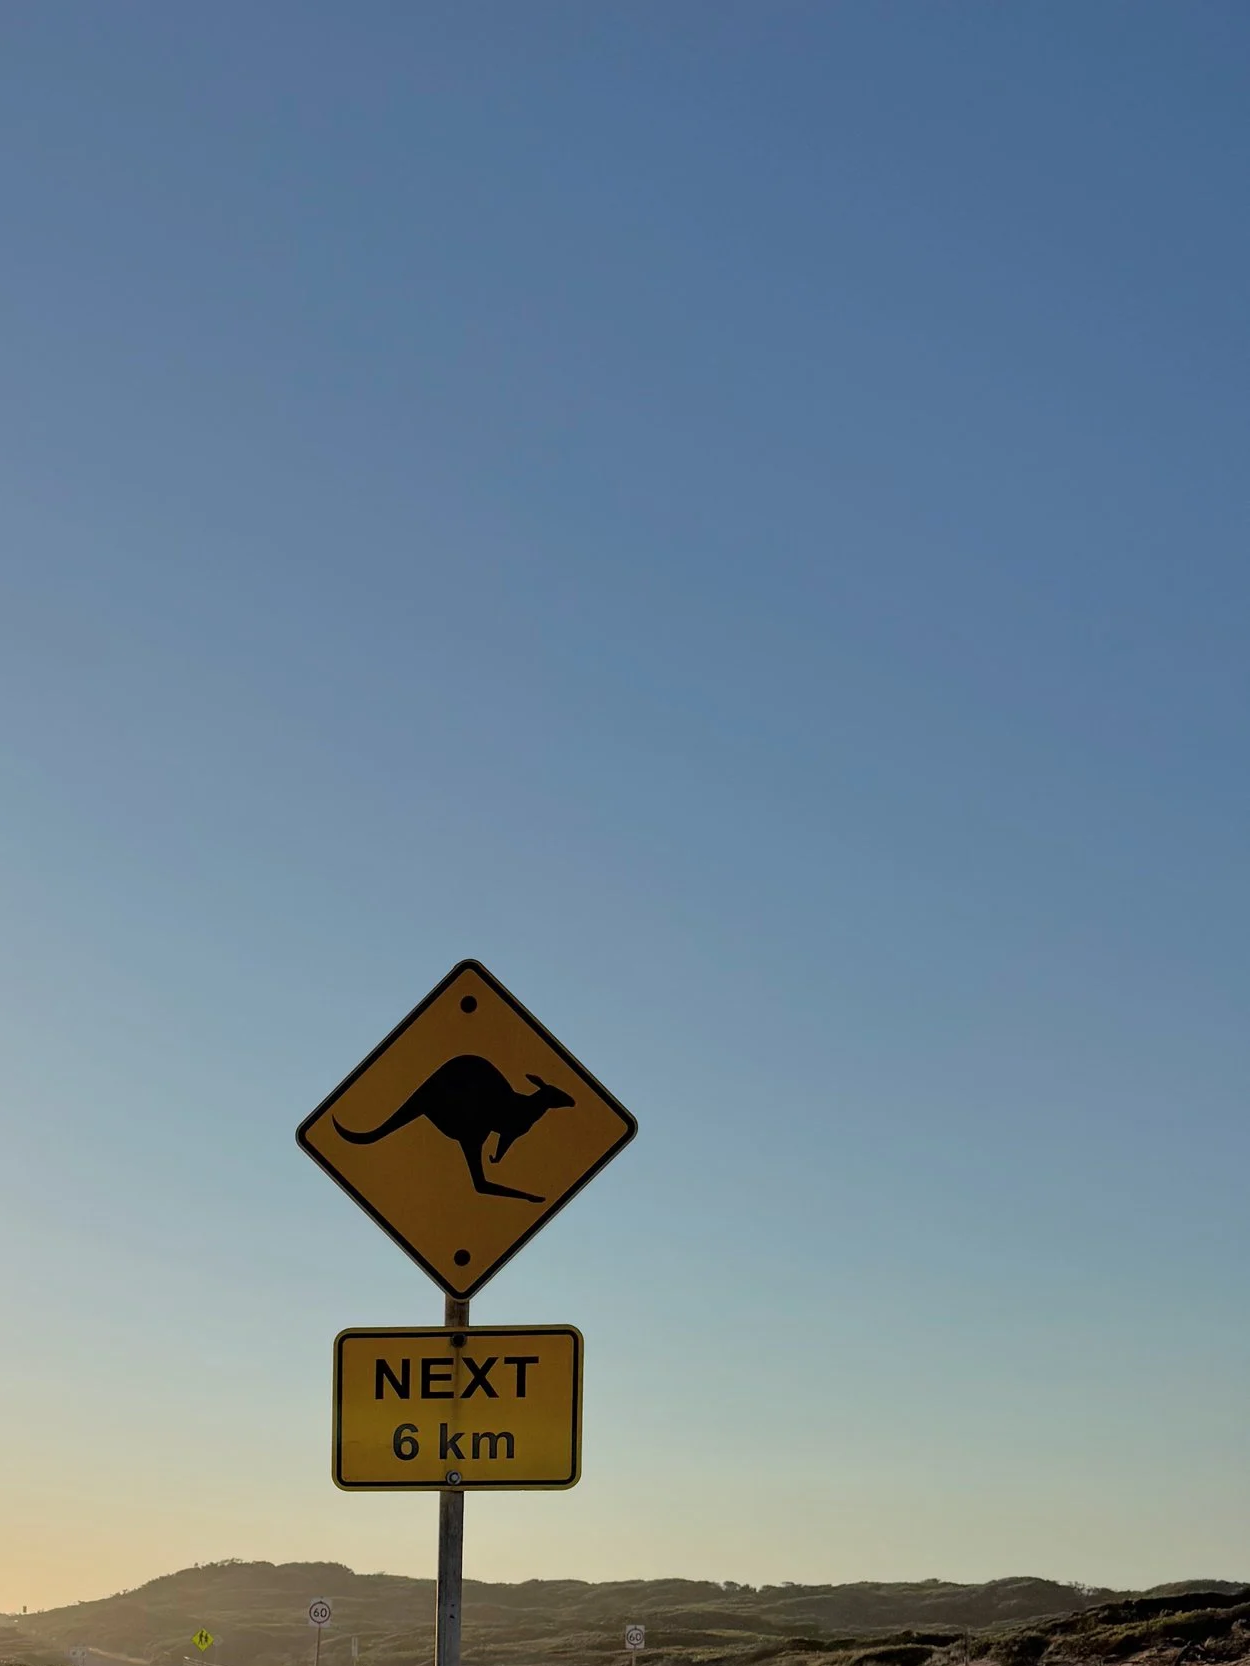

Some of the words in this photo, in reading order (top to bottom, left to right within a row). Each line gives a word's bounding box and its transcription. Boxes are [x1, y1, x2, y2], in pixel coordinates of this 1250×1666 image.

[375, 1356, 539, 1400] NEXT
[392, 1423, 420, 1461] 6
[439, 1422, 515, 1460] km
[313, 1607, 327, 1618] 60
[629, 1632, 641, 1641] 60
